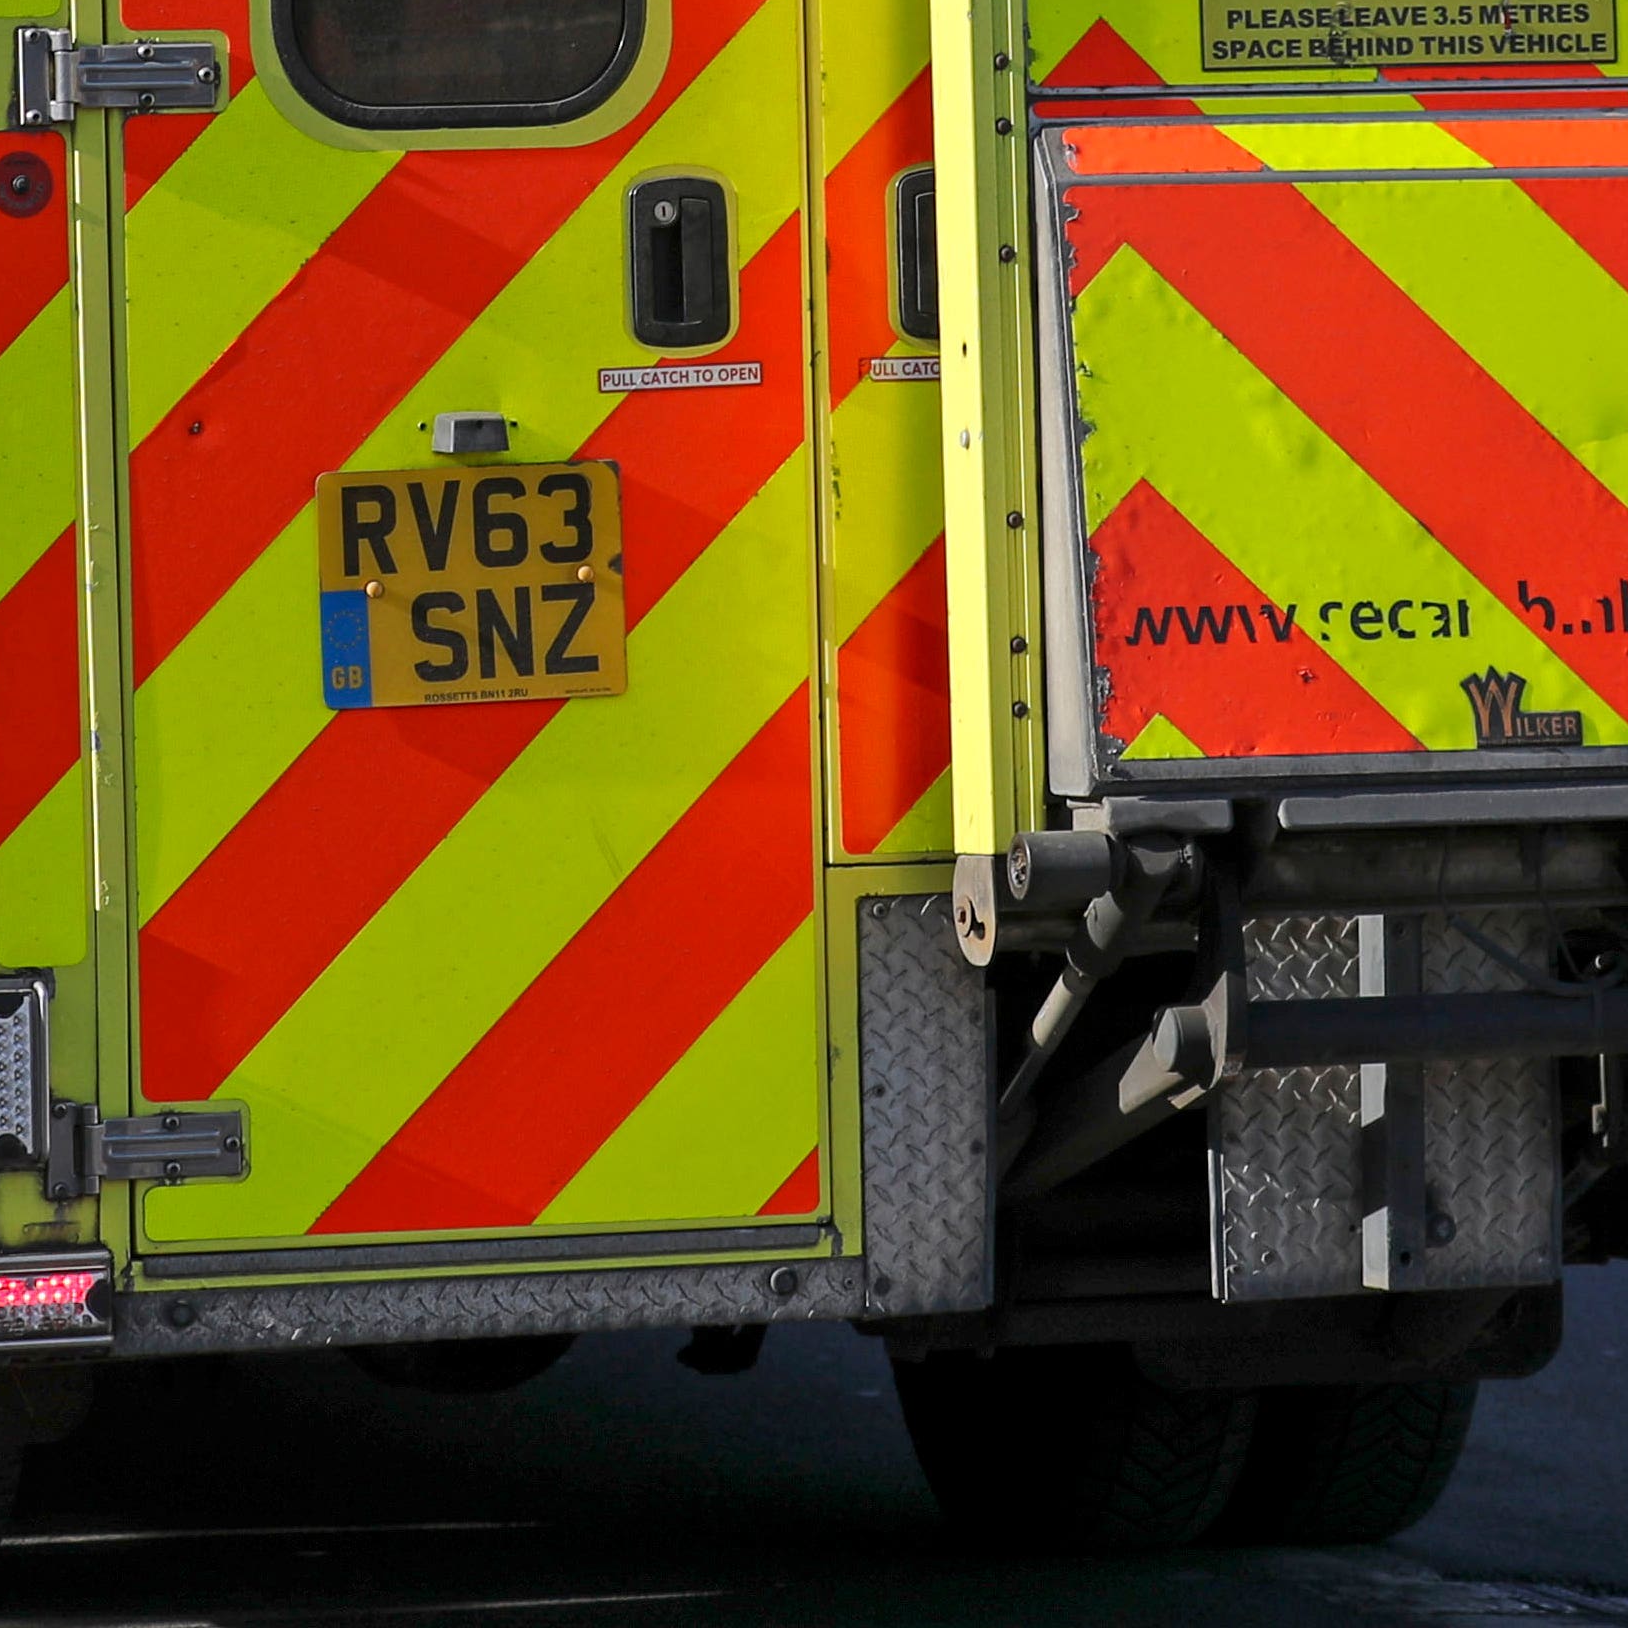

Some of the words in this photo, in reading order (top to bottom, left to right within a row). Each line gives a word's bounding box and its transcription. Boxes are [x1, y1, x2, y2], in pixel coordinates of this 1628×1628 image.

[1227, 8, 1332, 30] PLEASE
[1339, 6, 1427, 28] LEAVE
[1433, 5, 1473, 25] 3.5
[1479, 3, 1590, 25] METRES
[1212, 39, 1302, 60] SPACE
[1309, 37, 1414, 59] BEHIND
[1420, 35, 1484, 56] THIS
[1490, 33, 1607, 54] VEHICLE
[603, 373, 637, 387] PULL
[640, 371, 690, 385] CATCH
[693, 369, 713, 382] TO
[718, 367, 759, 381] OPEN
[873, 363, 899, 377] ULL
[902, 361, 940, 376] CATC
[340, 472, 594, 577] RV63
[411, 582, 600, 683] SNZ
[331, 665, 364, 690] GB
[424, 691, 478, 703] ROSSETTS
[481, 690, 505, 700] BN11
[507, 688, 529, 698] 2RU
[1469, 679, 1578, 738] WILKER
